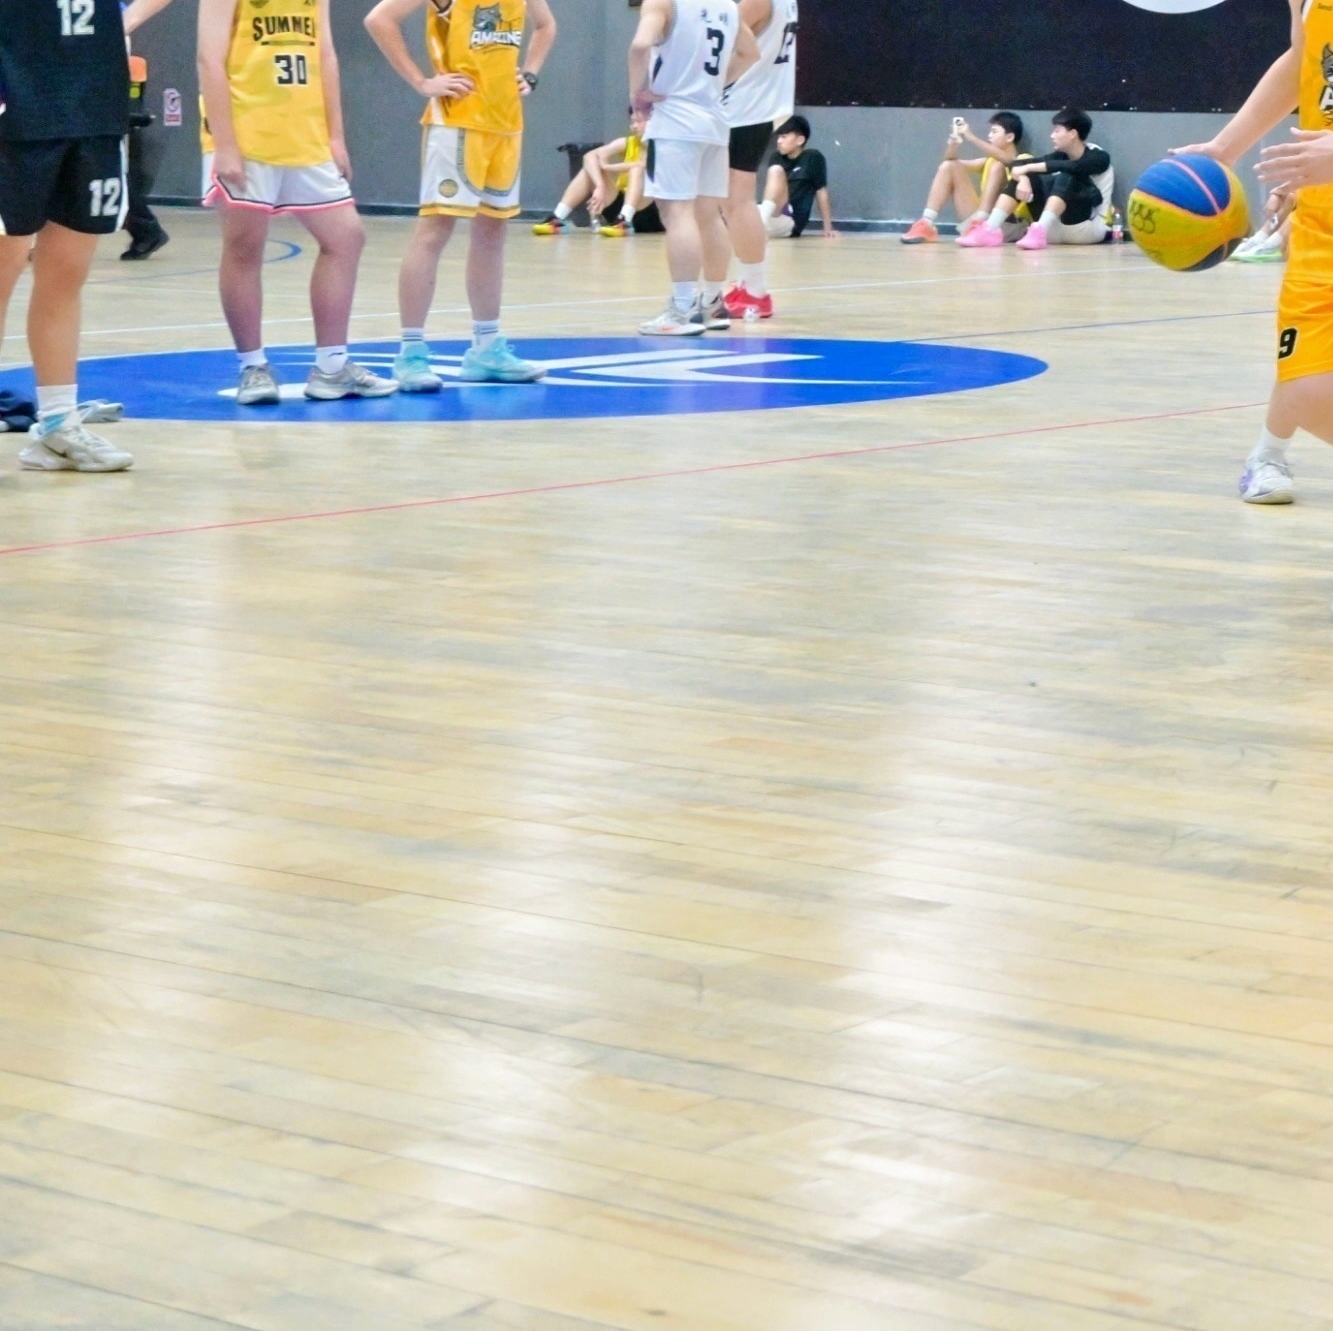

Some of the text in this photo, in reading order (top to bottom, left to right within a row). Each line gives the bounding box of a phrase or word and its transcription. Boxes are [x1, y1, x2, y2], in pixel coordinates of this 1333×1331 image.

[274, 54, 307, 85] 30
[703, 26, 725, 77] 3
[89, 176, 121, 217] 12
[1278, 326, 1298, 360] 9
